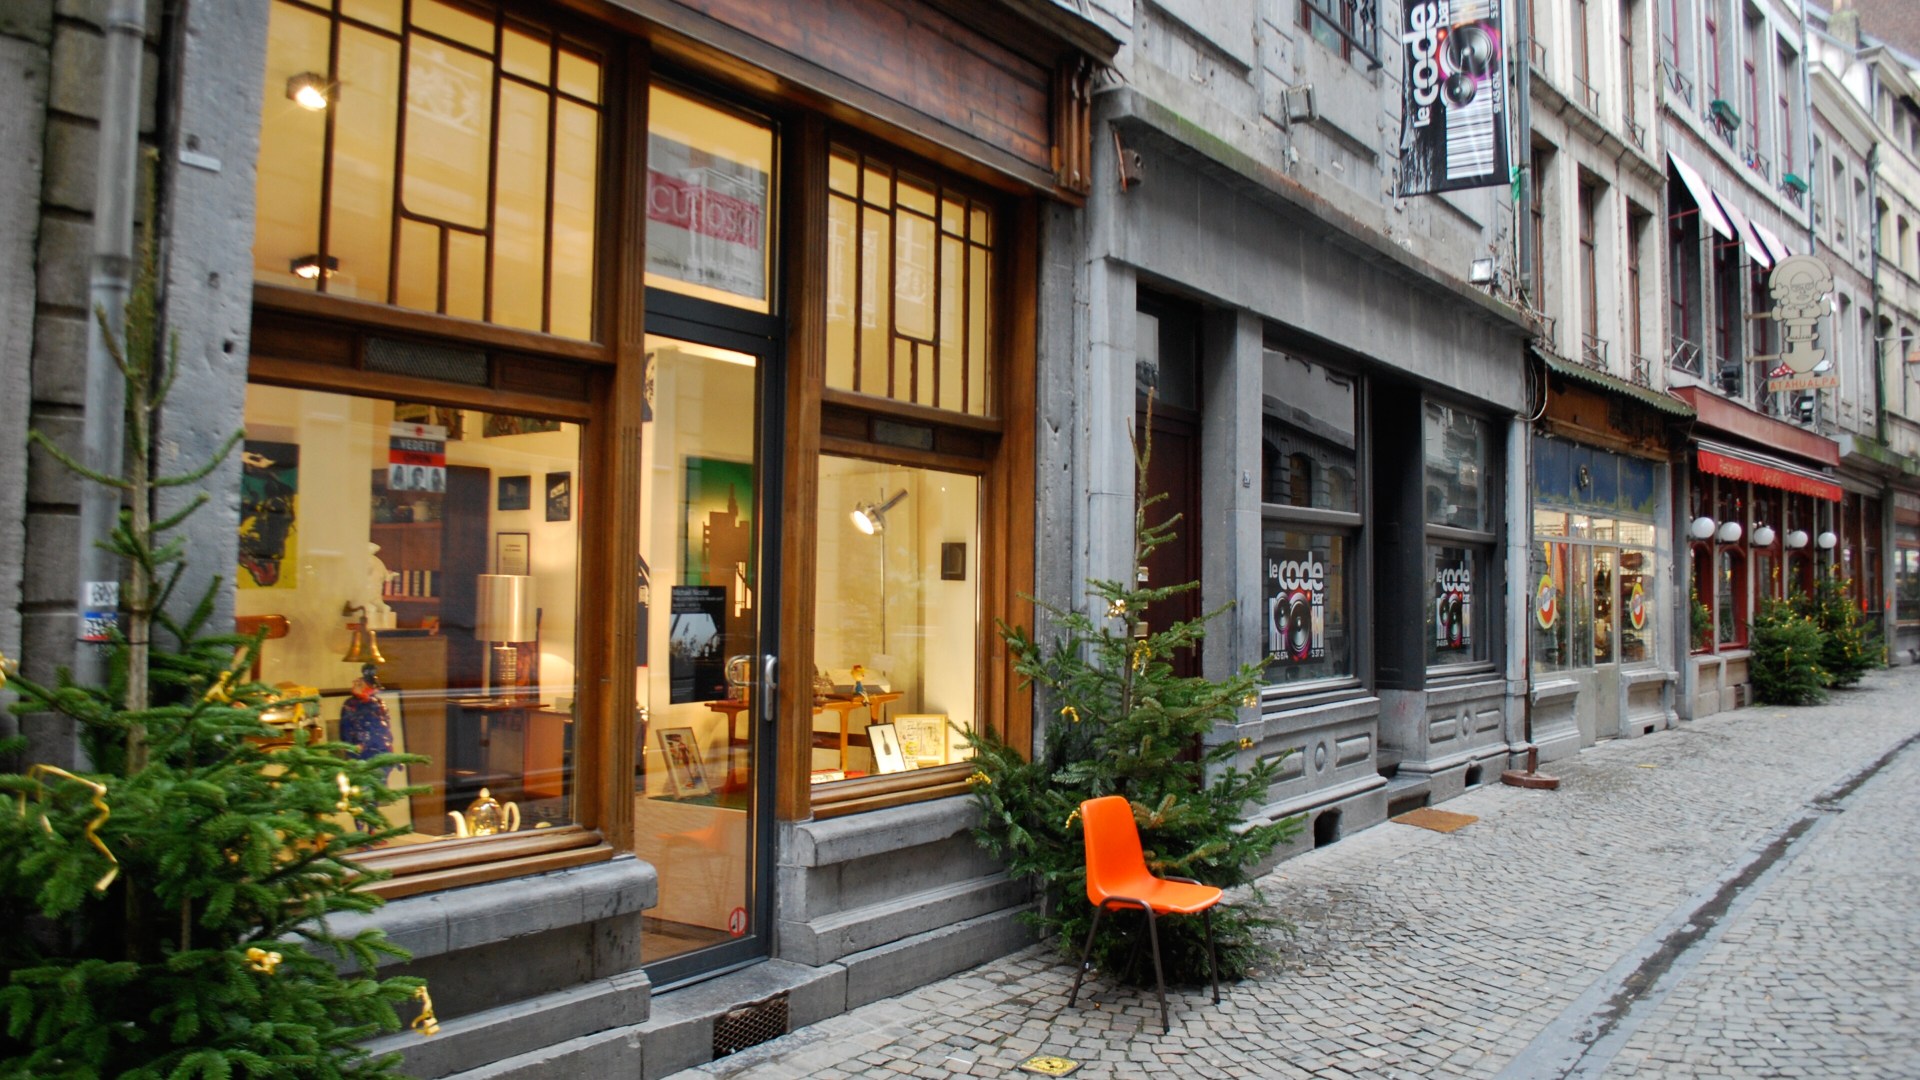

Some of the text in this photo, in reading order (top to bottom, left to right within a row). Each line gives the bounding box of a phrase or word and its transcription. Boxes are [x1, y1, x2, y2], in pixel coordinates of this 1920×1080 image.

[1435, 1, 1449, 27] bar
[1402, 2, 1438, 128] le code
[1770, 376, 1837, 391] ATAHUALPA
[400, 438, 437, 453] VEDETT
[1269, 551, 1324, 590] le code
[1442, 561, 1470, 592] code
[1311, 590, 1324, 604] bar
